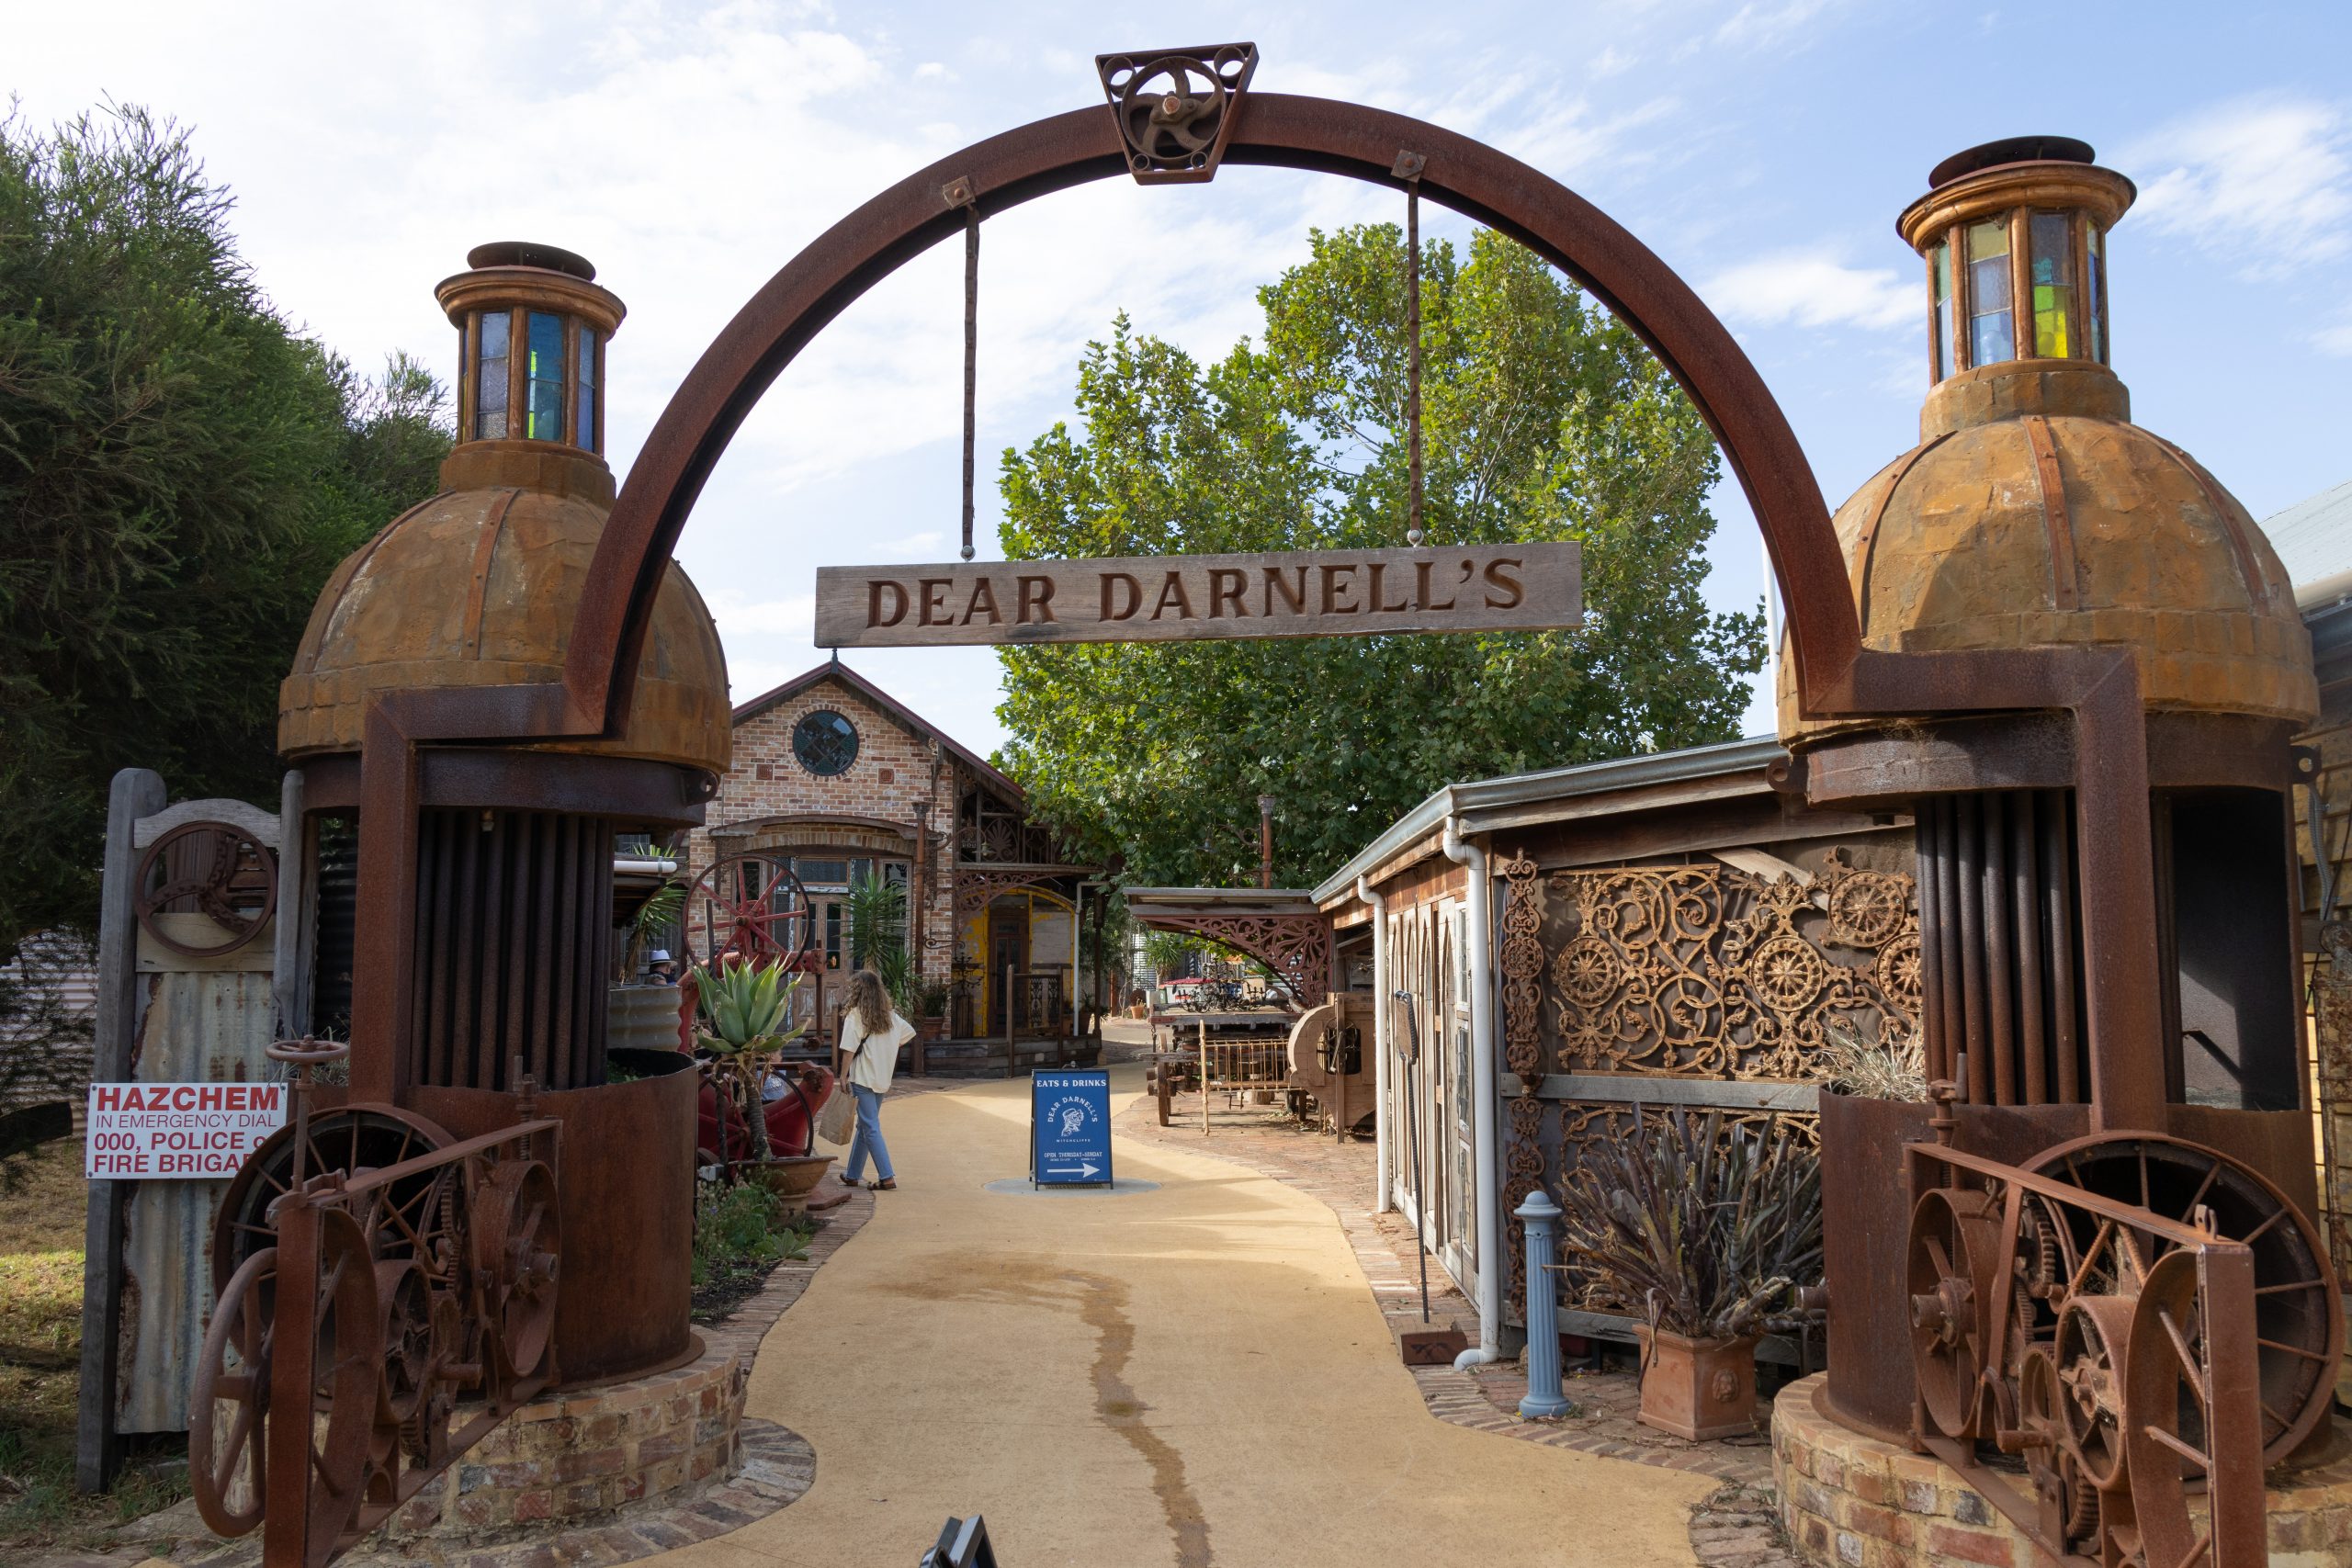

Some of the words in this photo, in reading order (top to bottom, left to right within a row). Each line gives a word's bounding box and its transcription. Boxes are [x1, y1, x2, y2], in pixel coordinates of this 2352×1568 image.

[866, 575, 1058, 628] DEAR
[1098, 558, 1524, 623] DARNELL'S
[1036, 1079, 1059, 1088] EATS
[1062, 1079, 1069, 1088] &
[97, 1087, 279, 1111] HAZCHEM
[1047, 1101, 1061, 1122] DEAR
[1061, 1096, 1098, 1122] DARNELL'S
[96, 1114, 113, 1128] IN
[119, 1113, 233, 1128] EMERGENCY
[239, 1113, 277, 1128] DIAL
[94, 1133, 141, 1154] 000,
[151, 1131, 245, 1150] POLICE
[94, 1154, 150, 1173] FIRE
[159, 1153, 254, 1173] BRIGA
